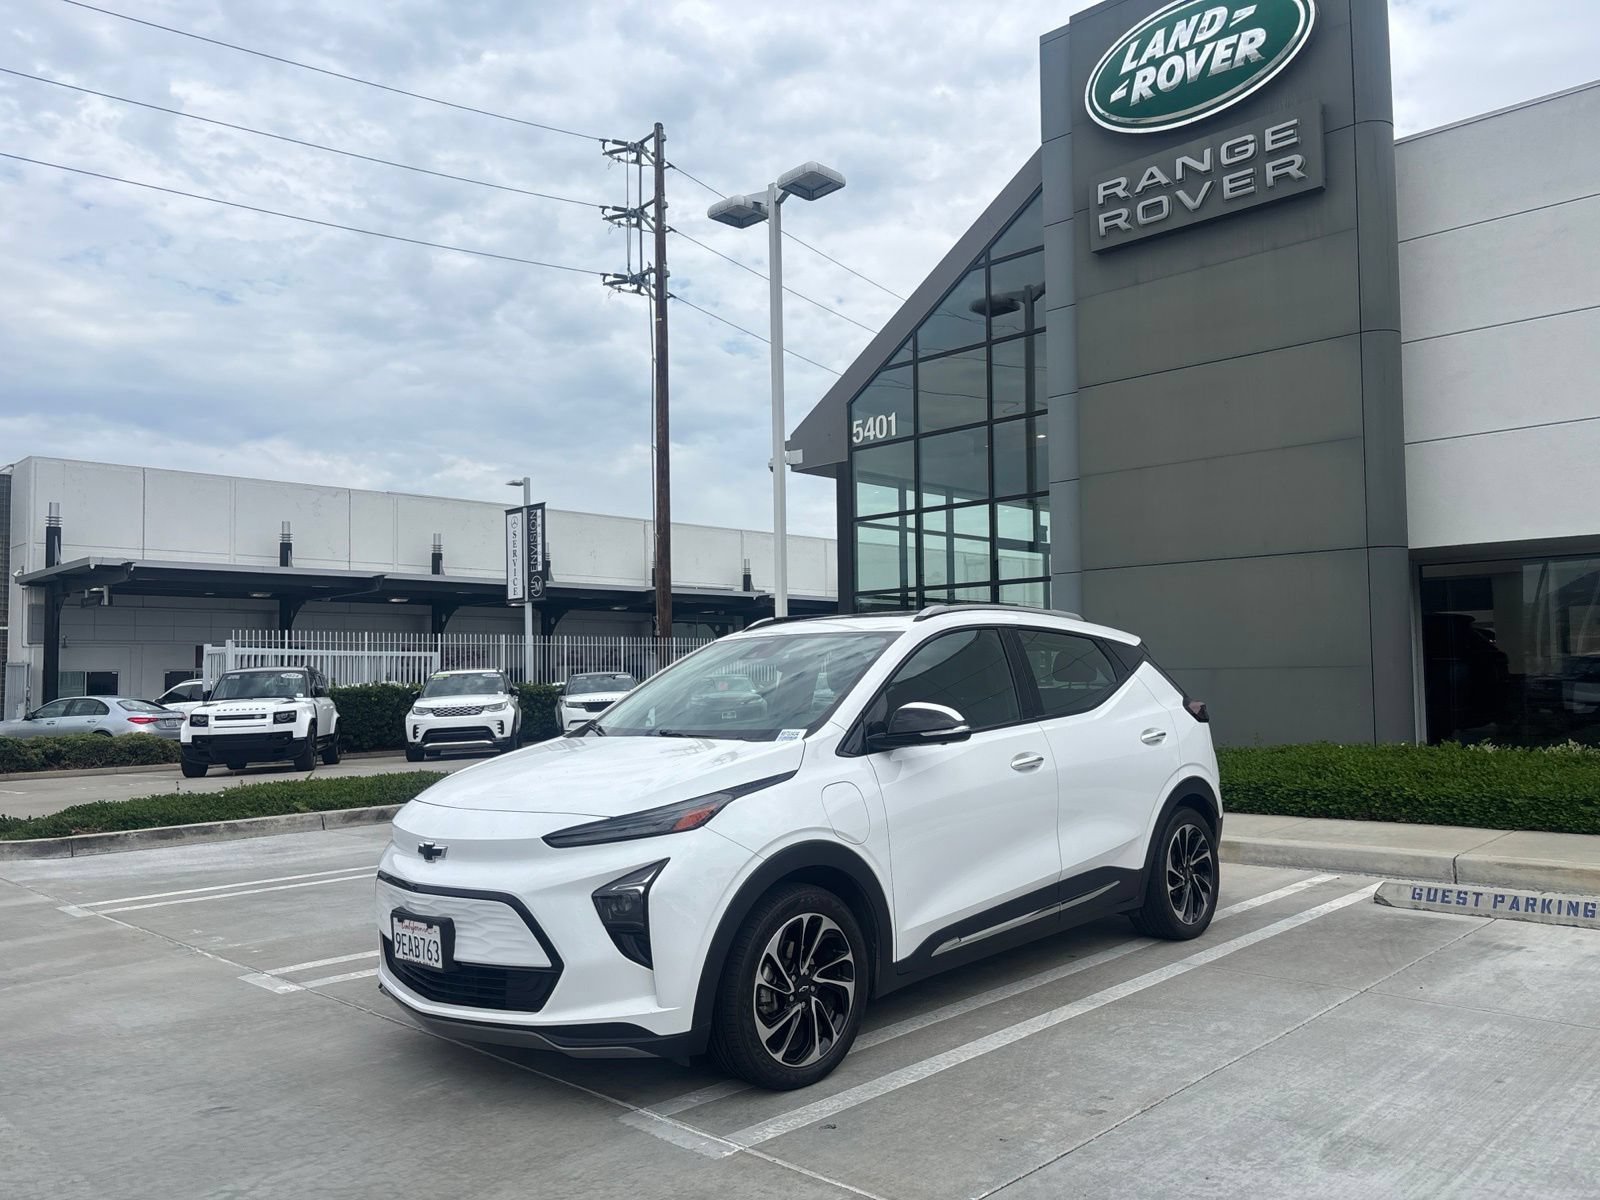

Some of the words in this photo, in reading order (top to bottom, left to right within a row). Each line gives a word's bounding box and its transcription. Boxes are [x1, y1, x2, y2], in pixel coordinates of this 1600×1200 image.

[1119, 6, 1228, 76] LAND
[1130, 28, 1266, 106] ROVER
[1097, 118, 1299, 205] RANGE
[1098, 154, 1307, 237] ROVER
[852, 411, 896, 444] 5401
[1411, 886, 1483, 907] GUEST
[1492, 894, 1597, 918] PARKING
[395, 932, 440, 963] 9EAB763
